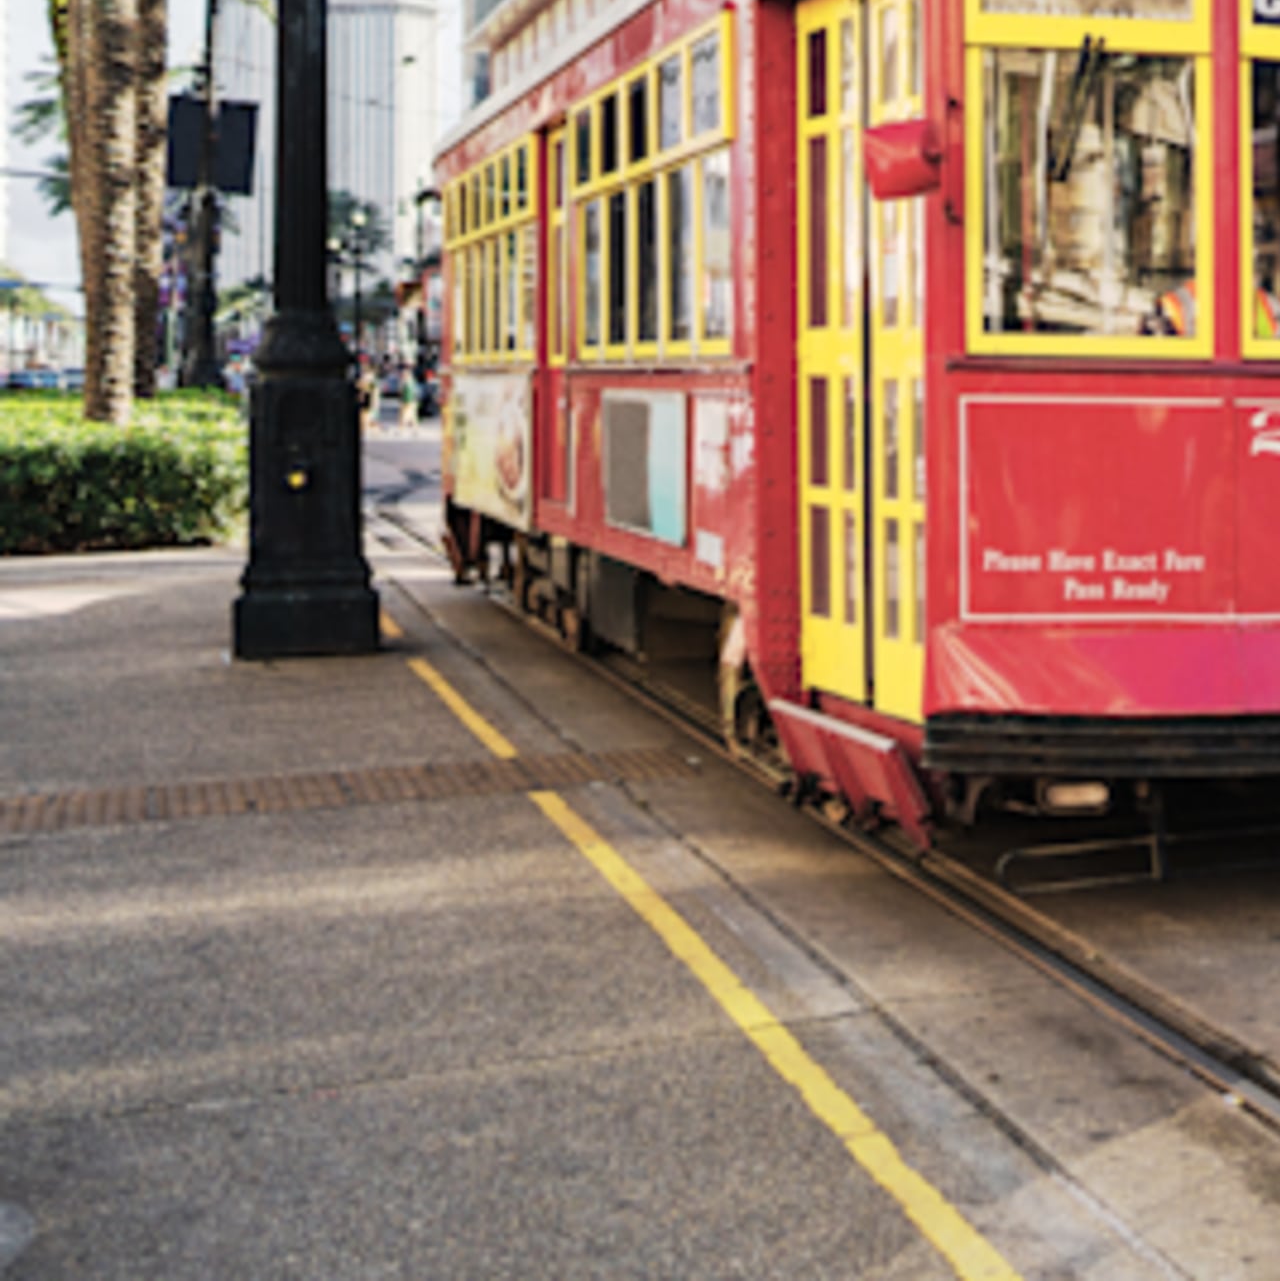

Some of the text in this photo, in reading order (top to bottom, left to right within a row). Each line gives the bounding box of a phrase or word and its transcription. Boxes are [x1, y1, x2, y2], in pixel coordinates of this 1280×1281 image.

[983, 548, 1042, 572] Please
[1103, 549, 1158, 572] Exact
[1112, 577, 1170, 604] Ready
